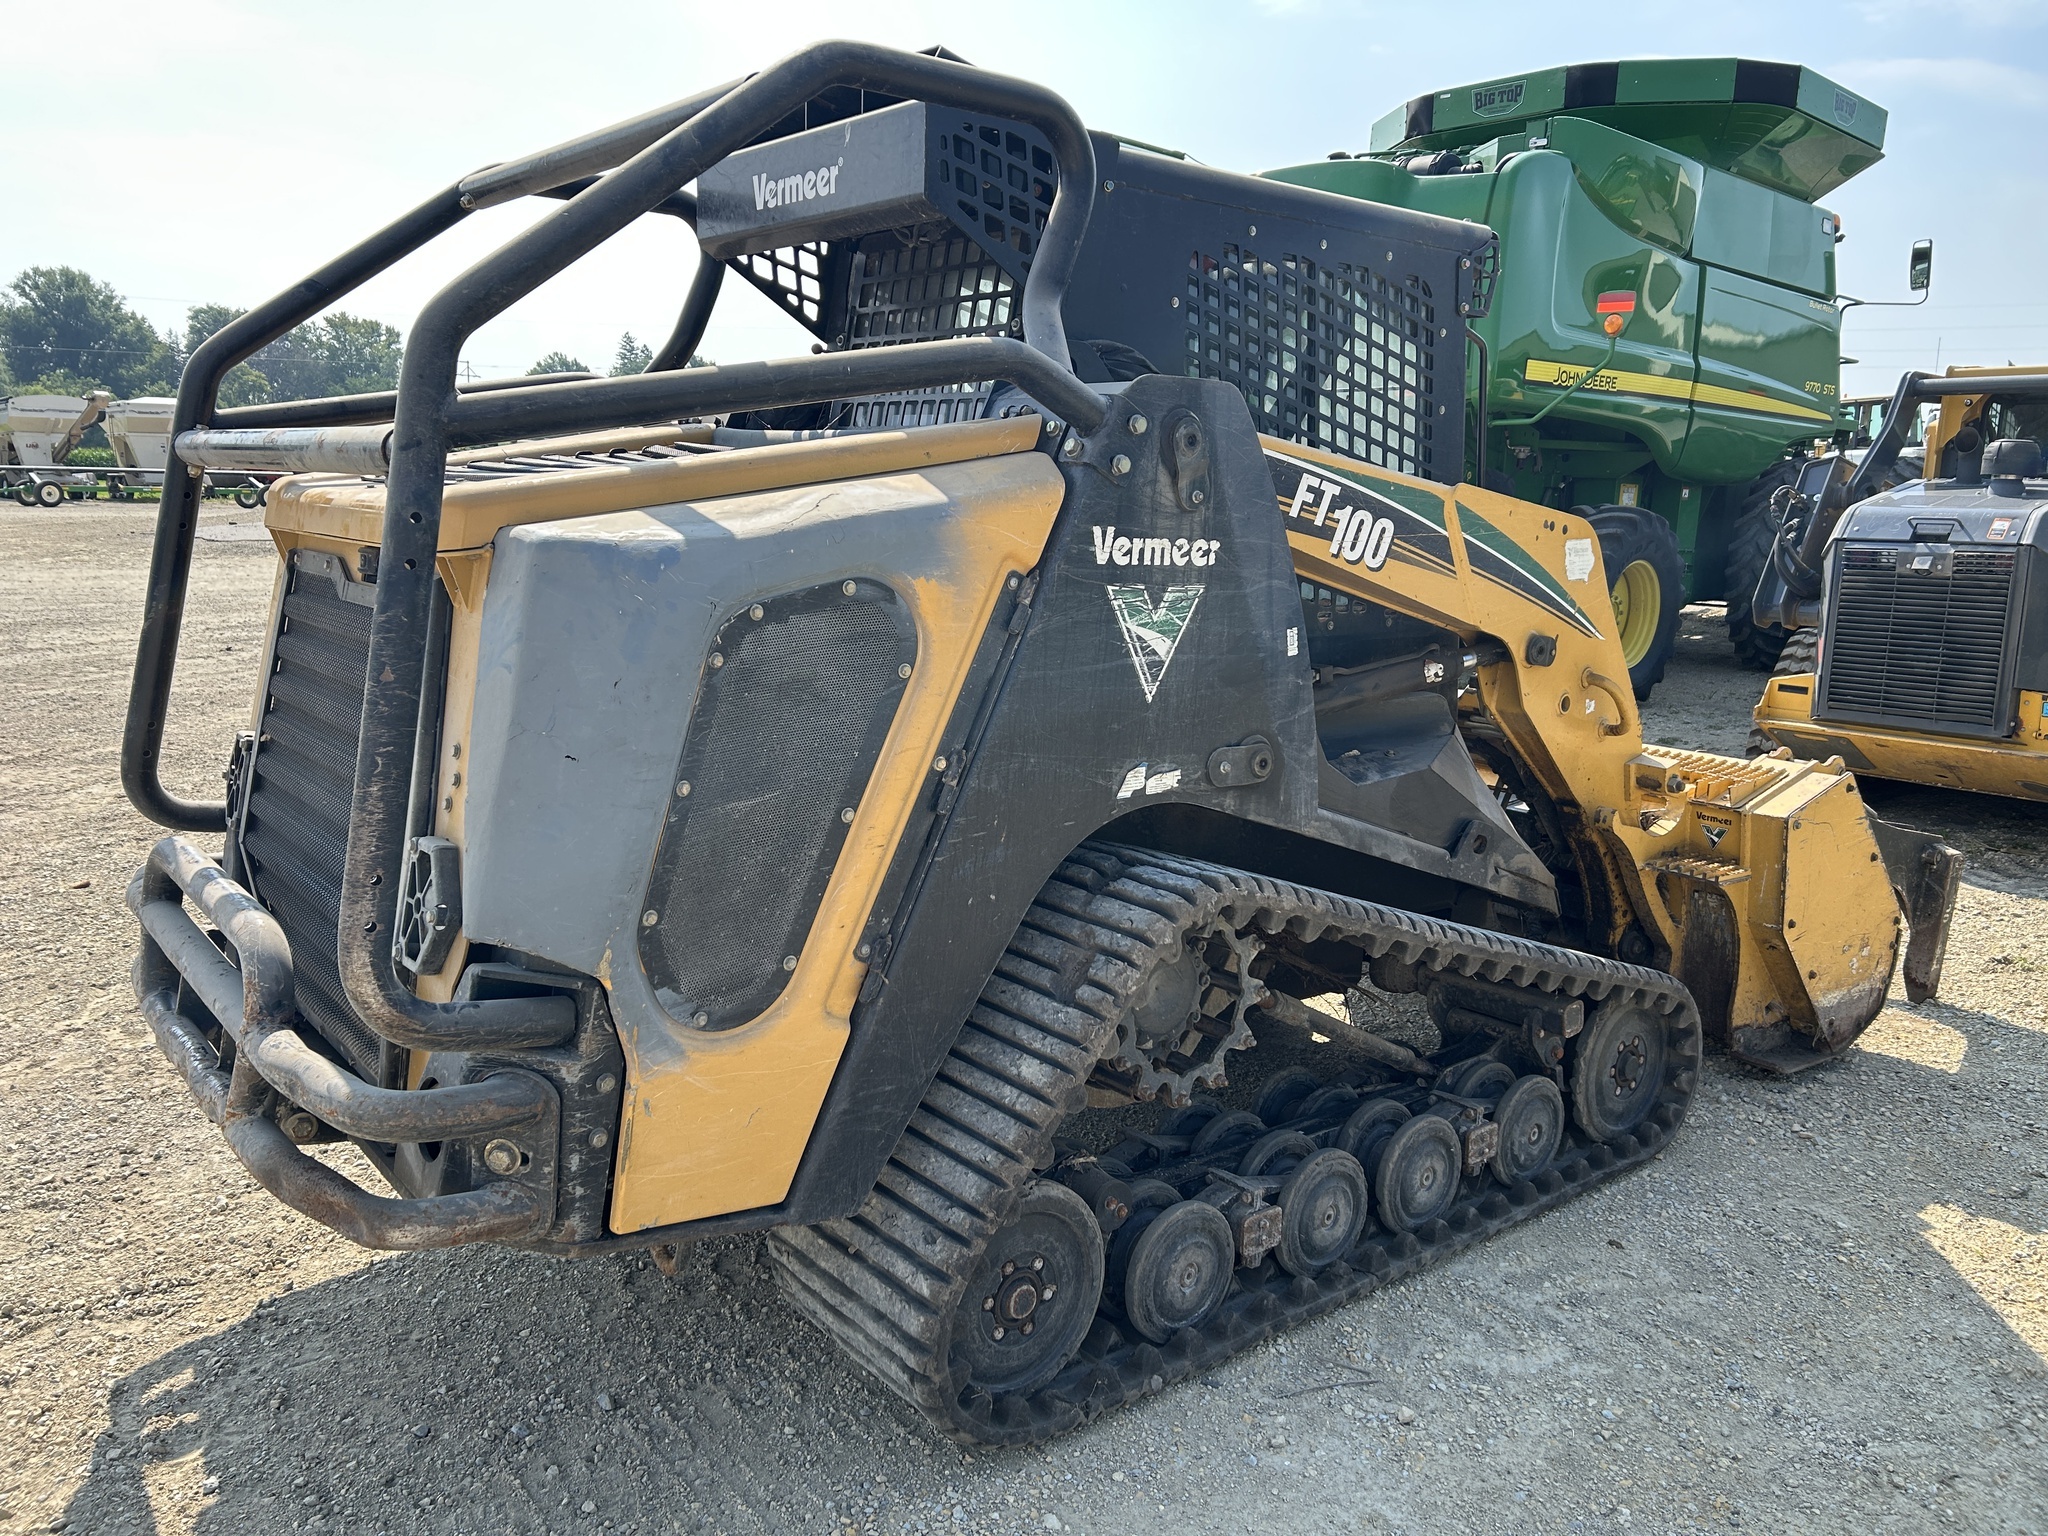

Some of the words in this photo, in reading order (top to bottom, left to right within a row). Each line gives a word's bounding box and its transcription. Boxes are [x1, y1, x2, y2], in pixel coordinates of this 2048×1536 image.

[1475, 92, 1496, 110] BIG
[1498, 84, 1523, 103] TOP
[752, 164, 839, 211] Vermeer
[1552, 366, 1584, 387] JOHN
[1804, 380, 1821, 394] 9770
[1822, 383, 1836, 396] STS
[1092, 525, 1221, 567] Vermeer
[1696, 811, 1733, 826] Vermeer
